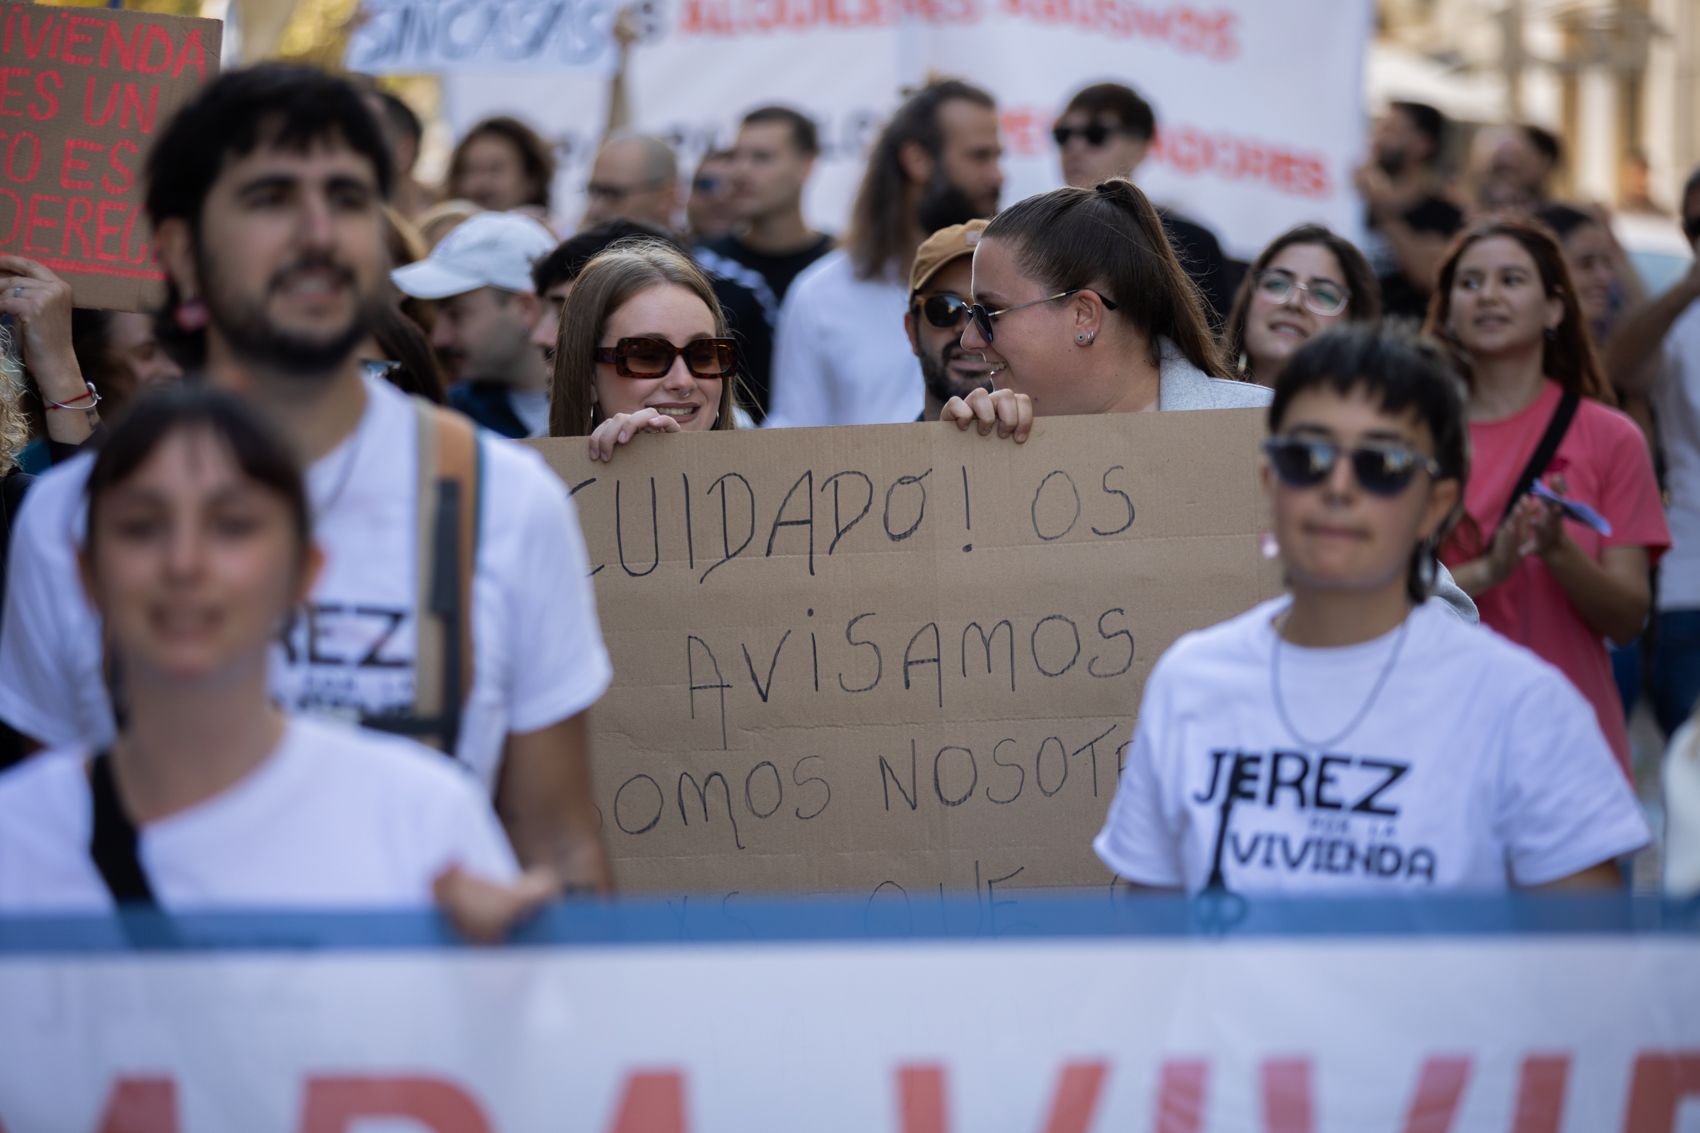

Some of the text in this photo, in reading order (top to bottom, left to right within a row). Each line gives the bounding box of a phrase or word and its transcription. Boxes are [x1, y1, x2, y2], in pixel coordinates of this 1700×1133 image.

[0, 4, 207, 81] iViENDA
[83, 76, 161, 134] UN
[0, 130, 138, 195] O ES
[0, 187, 160, 266] DEREC
[1032, 465, 1136, 540] OS
[592, 755, 832, 850] OMOS
[1194, 747, 1410, 818] JEREZ
[1231, 831, 1438, 884] VIVIENDA
